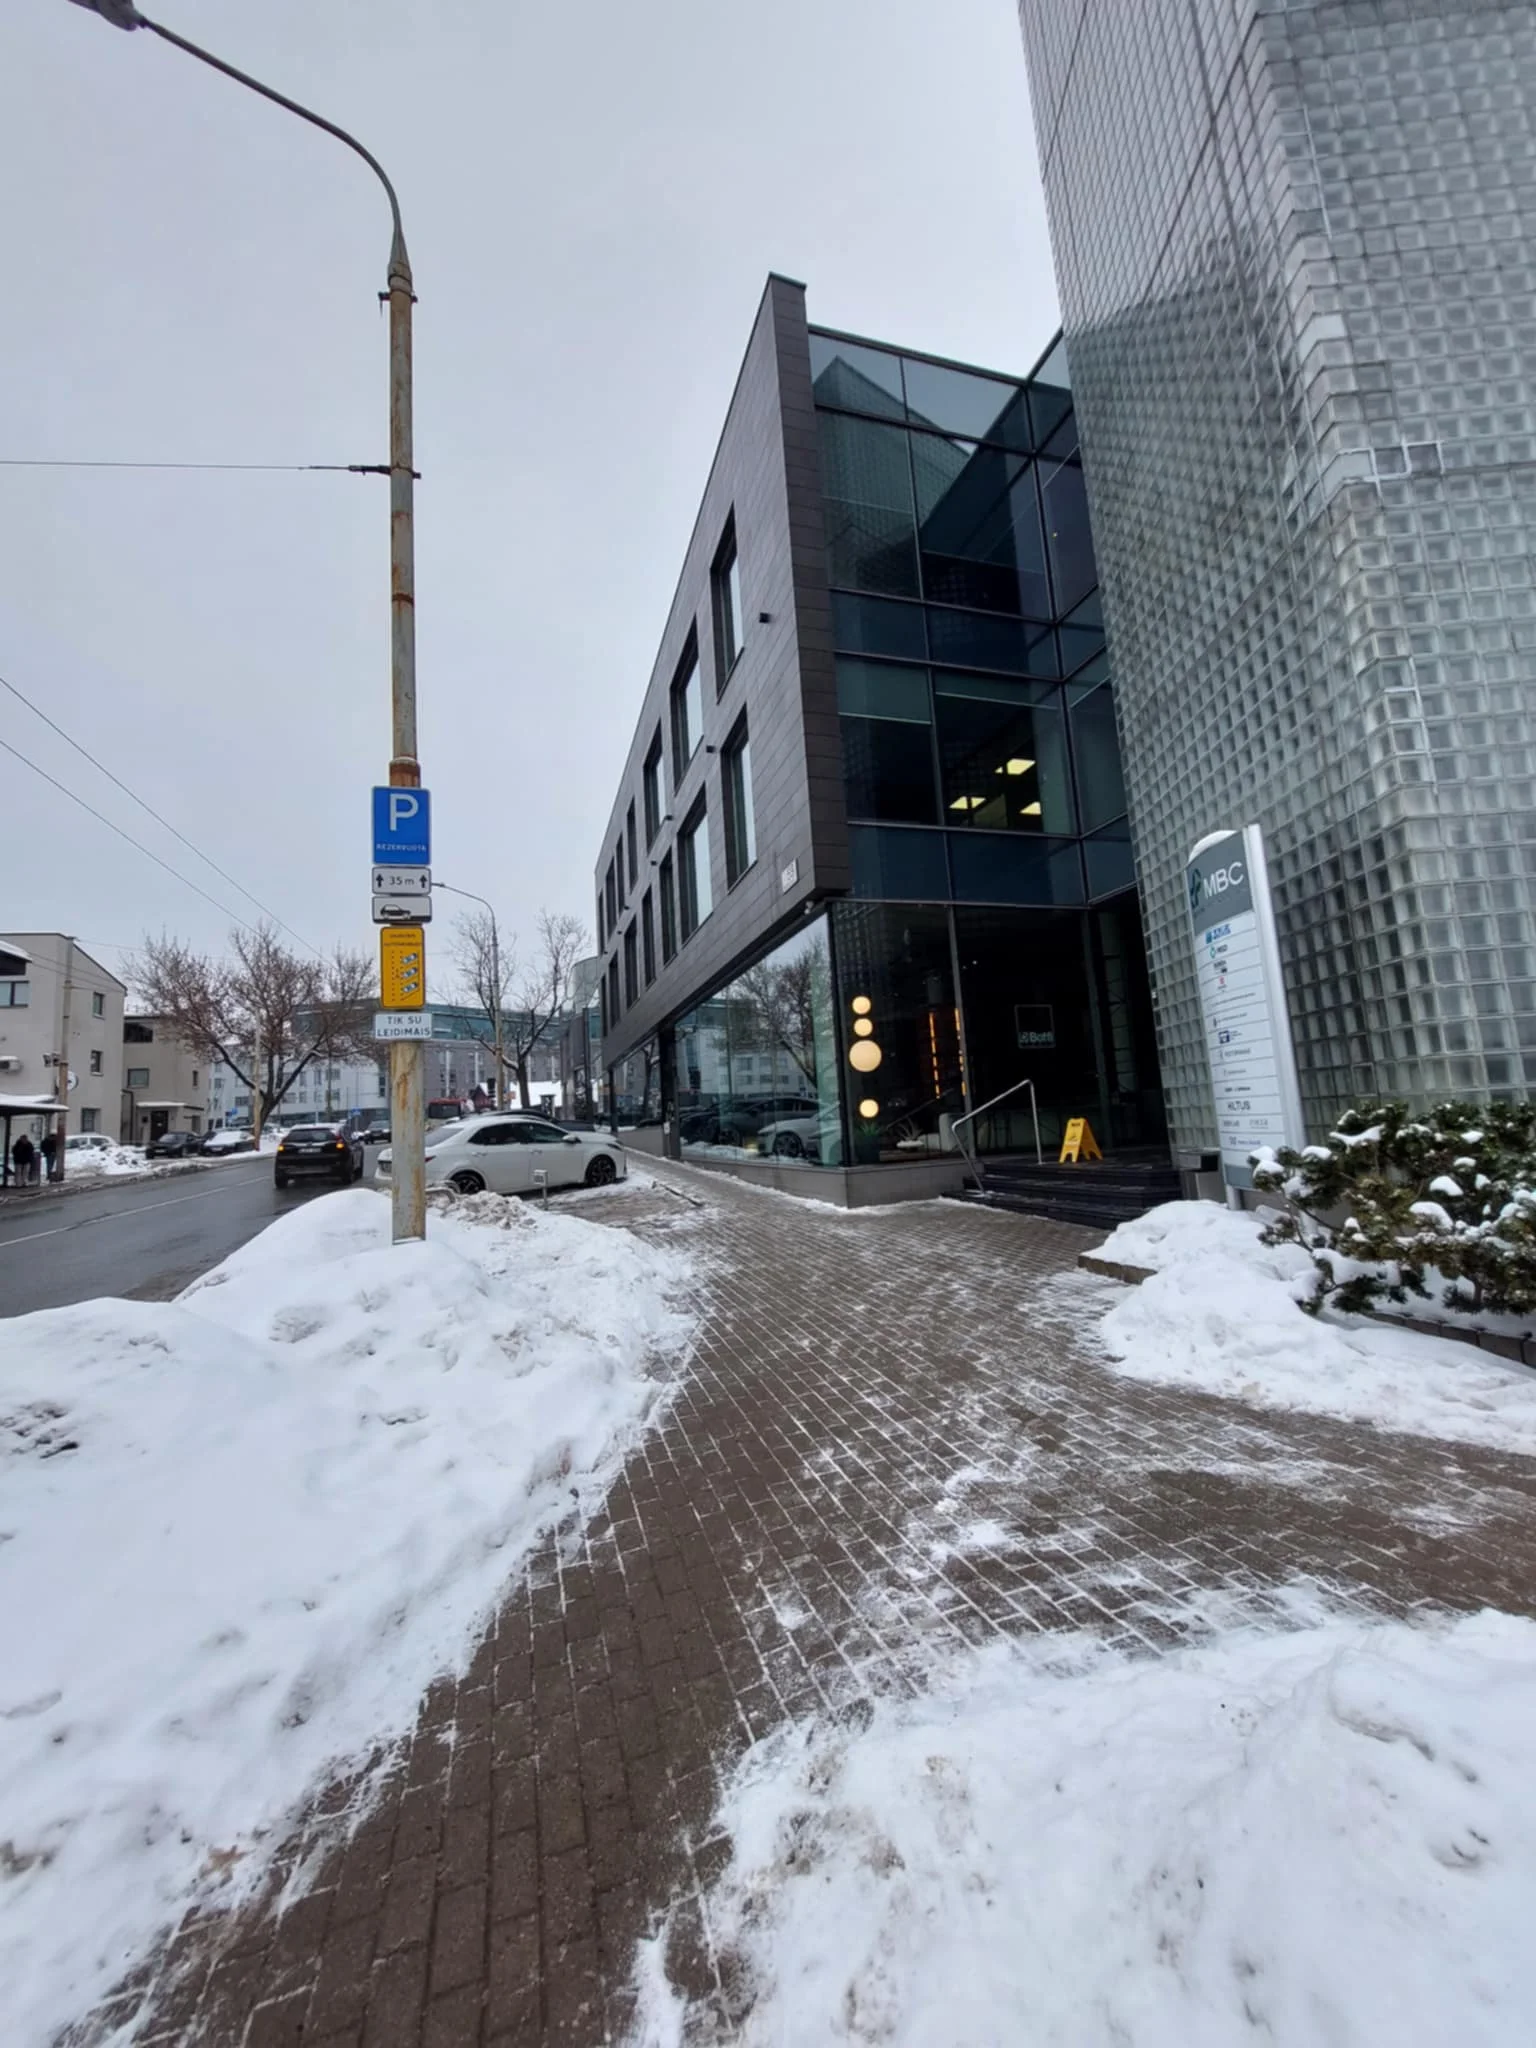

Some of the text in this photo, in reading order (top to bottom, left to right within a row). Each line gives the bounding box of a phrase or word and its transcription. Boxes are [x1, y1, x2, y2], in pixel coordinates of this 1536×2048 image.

[390, 793, 419, 831] P
[389, 876, 403, 885] 35
[1203, 861, 1244, 899] MBC
[387, 1015, 422, 1025] TIK SU
[377, 1027, 430, 1037] LEIDIMAIS
